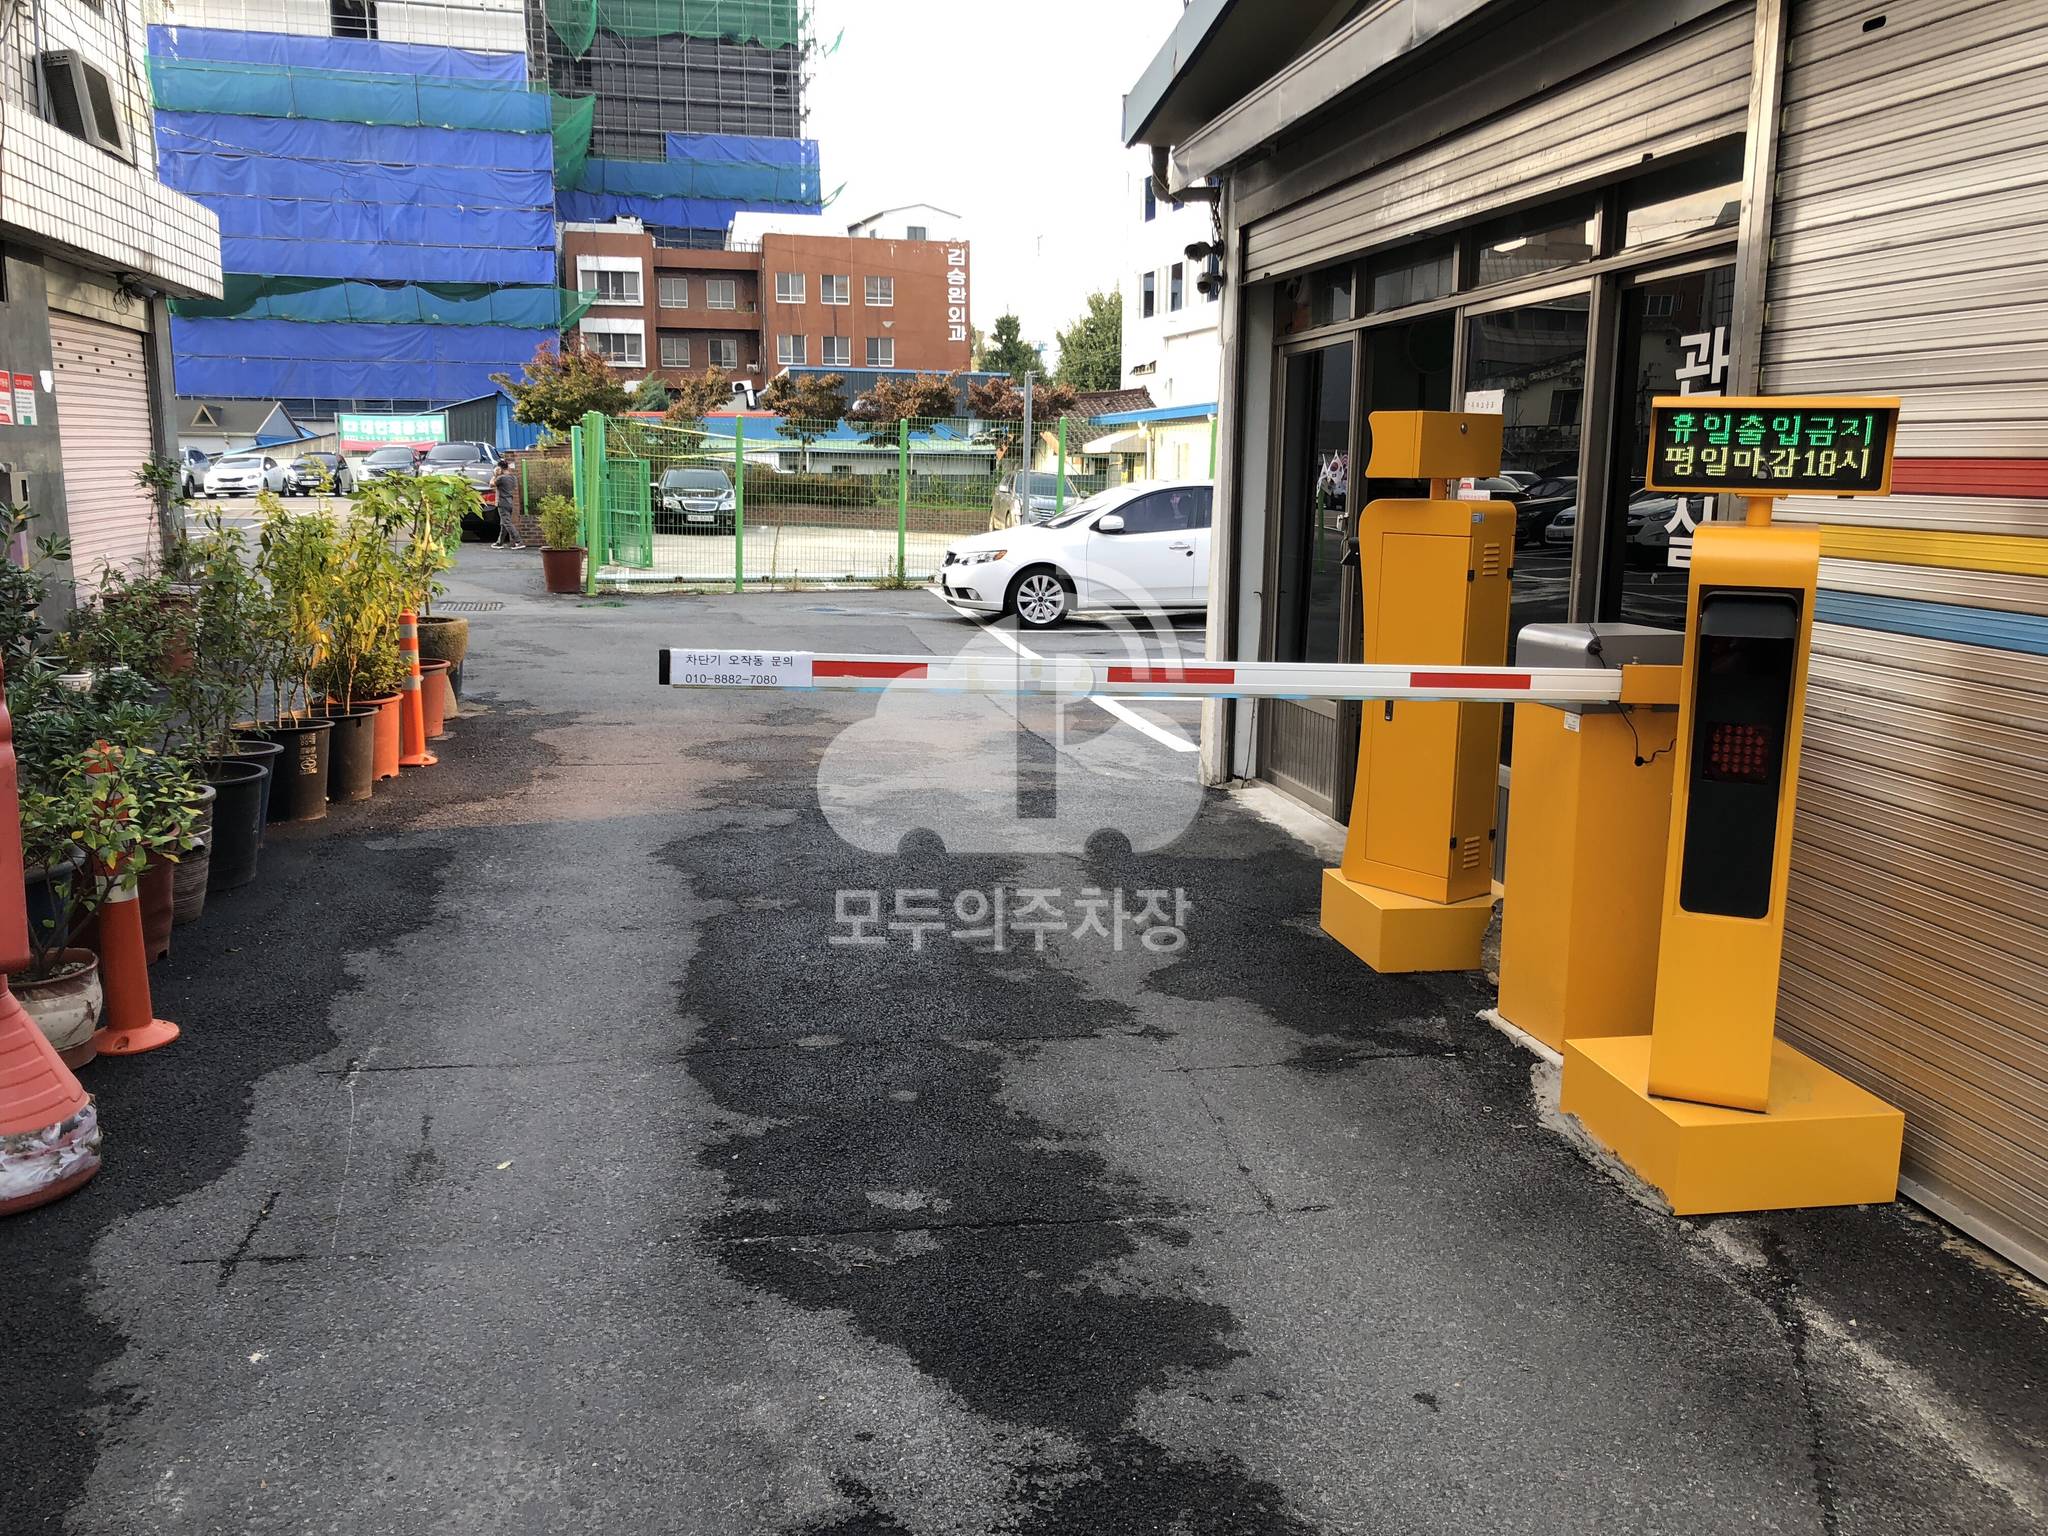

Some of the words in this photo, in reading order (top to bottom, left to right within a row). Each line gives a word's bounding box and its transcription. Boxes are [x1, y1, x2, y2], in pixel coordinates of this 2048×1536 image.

[1667, 413, 1873, 447] 휴일출입금지
[685, 654, 721, 666] 차단기
[728, 654, 764, 667] 오작동
[771, 655, 793, 667] 문의
[685, 673, 778, 685] 010-8882-7080
